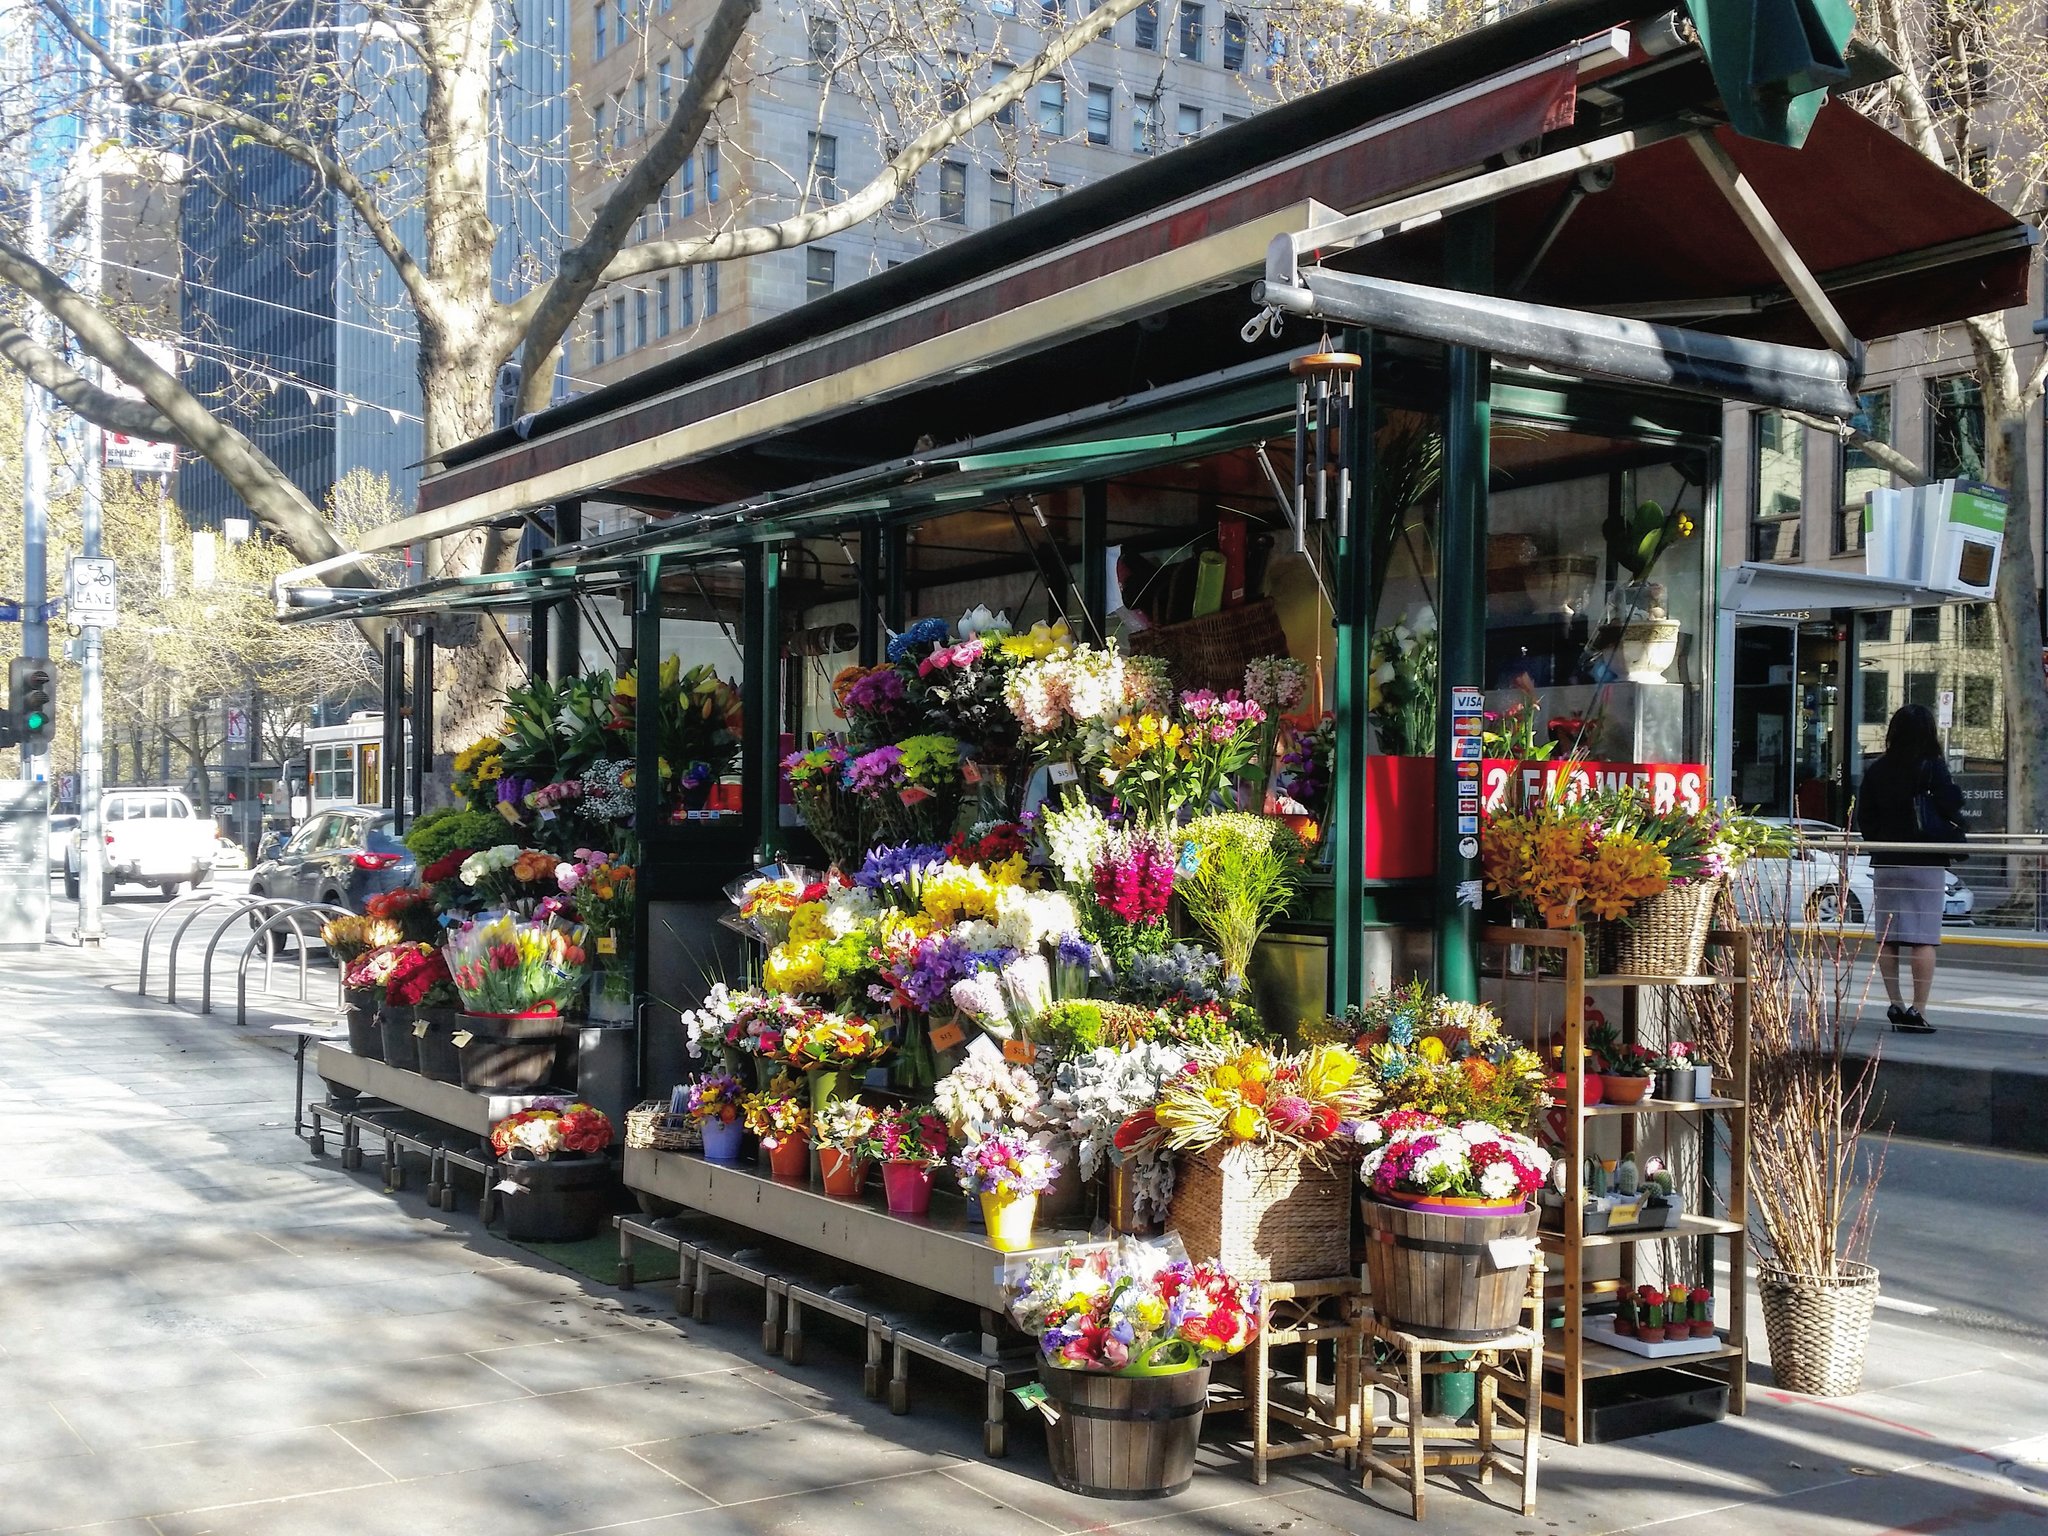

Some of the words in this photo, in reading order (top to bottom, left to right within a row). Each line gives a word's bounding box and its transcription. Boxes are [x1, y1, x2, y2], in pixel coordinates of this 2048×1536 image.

[77, 591, 111, 605] LANE
[1458, 696, 1482, 707] VISA
[1974, 790, 2004, 799] SUITES
